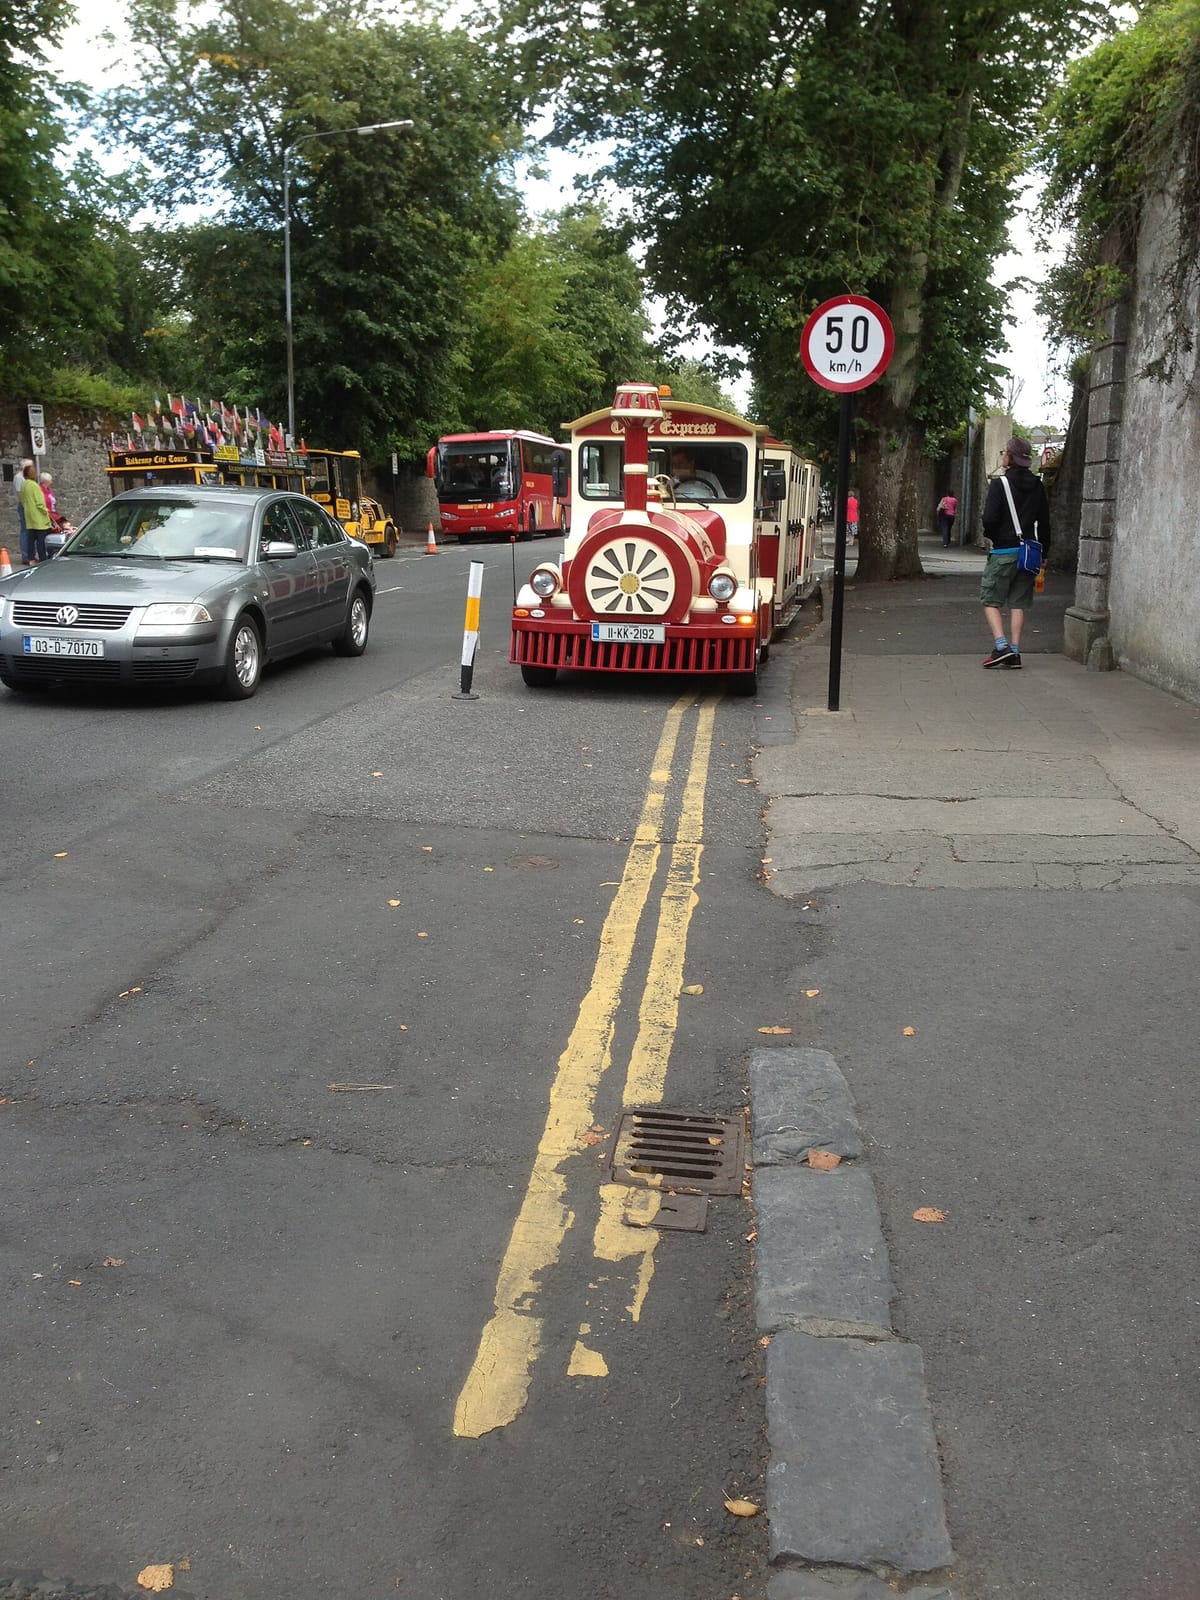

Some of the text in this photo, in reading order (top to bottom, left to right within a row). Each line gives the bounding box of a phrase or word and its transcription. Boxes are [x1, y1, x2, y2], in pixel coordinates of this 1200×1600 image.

[826, 316, 869, 353] 50
[829, 359, 862, 373] km/h
[660, 420, 717, 437] Express
[153, 455, 167, 464] City
[168, 455, 188, 463] Tours
[608, 627, 655, 639] 11-KK-2192
[35, 640, 98, 655] 03-D-70170
